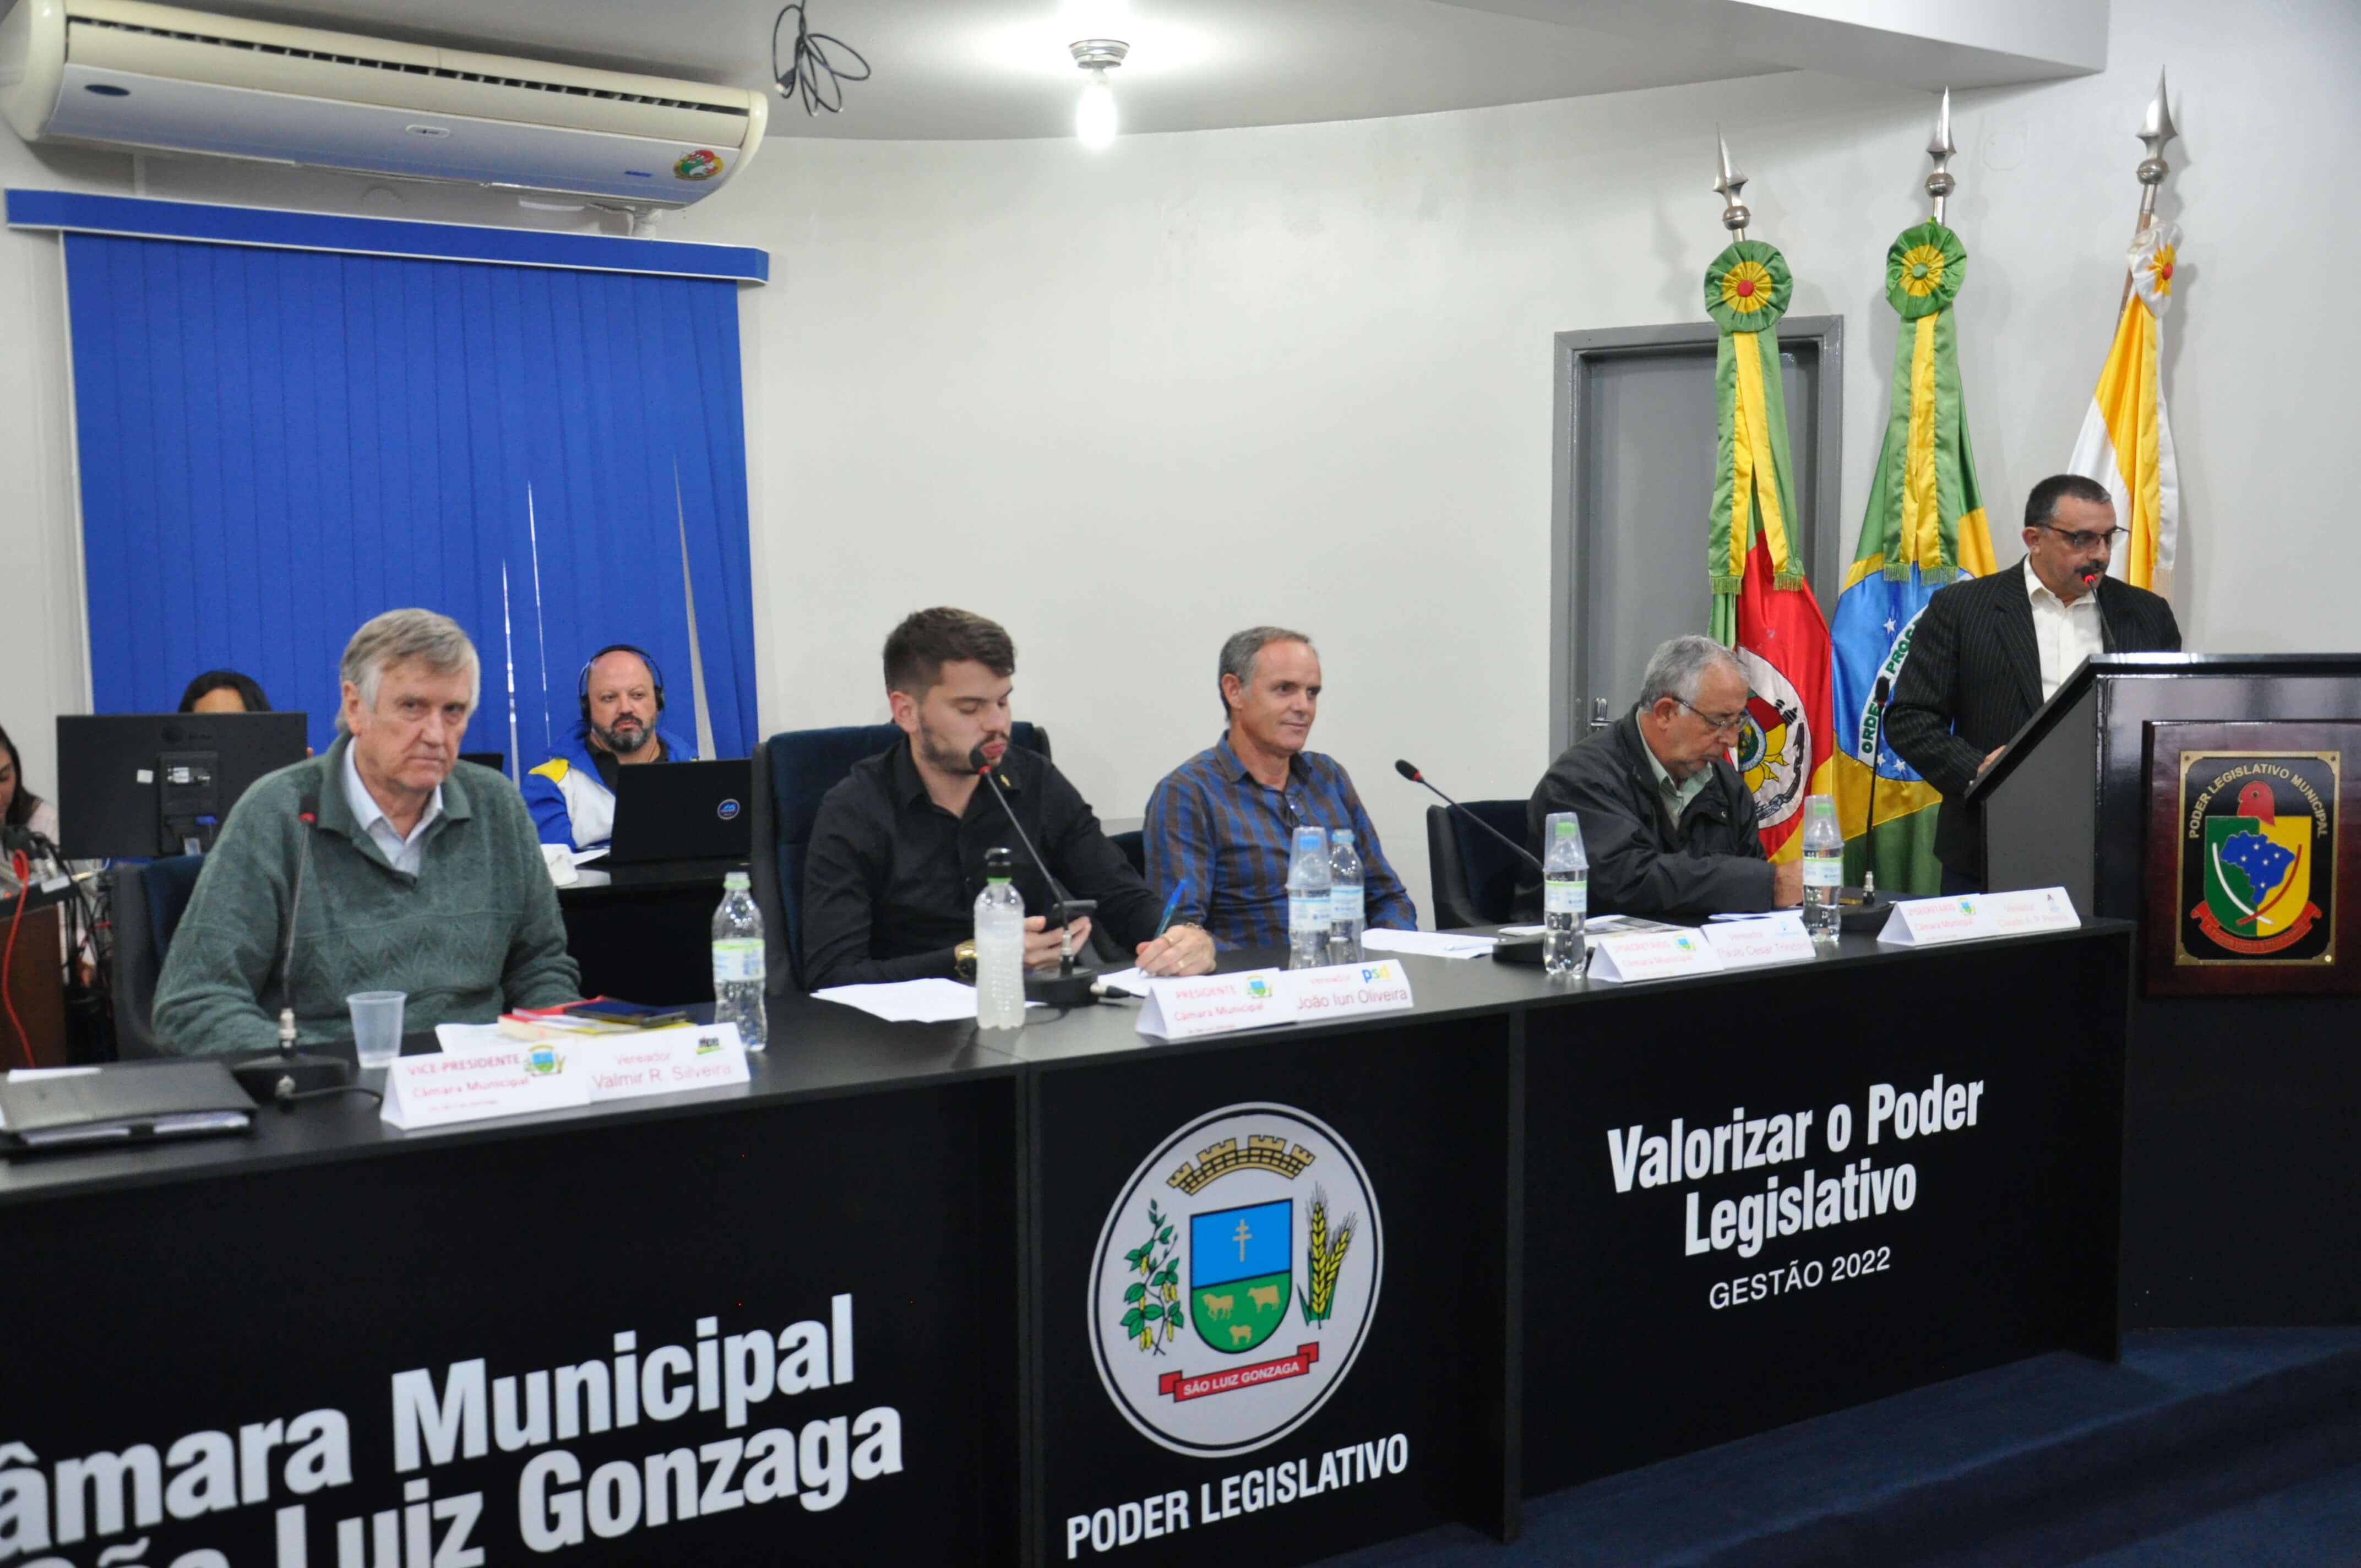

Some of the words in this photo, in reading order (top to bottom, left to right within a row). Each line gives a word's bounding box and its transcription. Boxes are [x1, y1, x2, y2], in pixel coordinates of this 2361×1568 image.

[1862, 697, 1879, 754] ORDE
[2189, 793, 2212, 839] PODER
[2207, 763, 2289, 794] LEGISLATIVO
[2290, 774, 2329, 839] MUNICIPAL
[1176, 985, 1236, 999] PRESIDENTE
[1297, 995, 1330, 1010] João
[1358, 988, 1408, 1004] Oliveira
[1362, 964, 1390, 983] psd
[1215, 1003, 1264, 1015] Municipal
[467, 1076, 530, 1092] Municipal
[591, 1071, 643, 1088] Valmir
[672, 1063, 732, 1081] Silveira
[1607, 1106, 1813, 1193] Valorizar
[1827, 1104, 1852, 1152] o
[1867, 1074, 1984, 1145] Poder
[1685, 1157, 1917, 1258] Legislativo
[1709, 1260, 1824, 1310] GESTÃO
[1831, 1245, 1891, 1282] 2022
[1183, 1381, 1210, 1396] SÃO
[1212, 1374, 1239, 1389] LUIZ
[1241, 1361, 1300, 1382] GONZAGA
[0, 1408, 353, 1560] âmara
[391, 1293, 853, 1473] Municipal
[519, 1406, 903, 1552] Gonzaga
[1067, 1490, 1190, 1559] PODER
[1201, 1433, 1408, 1523] LEGISLATIVO
